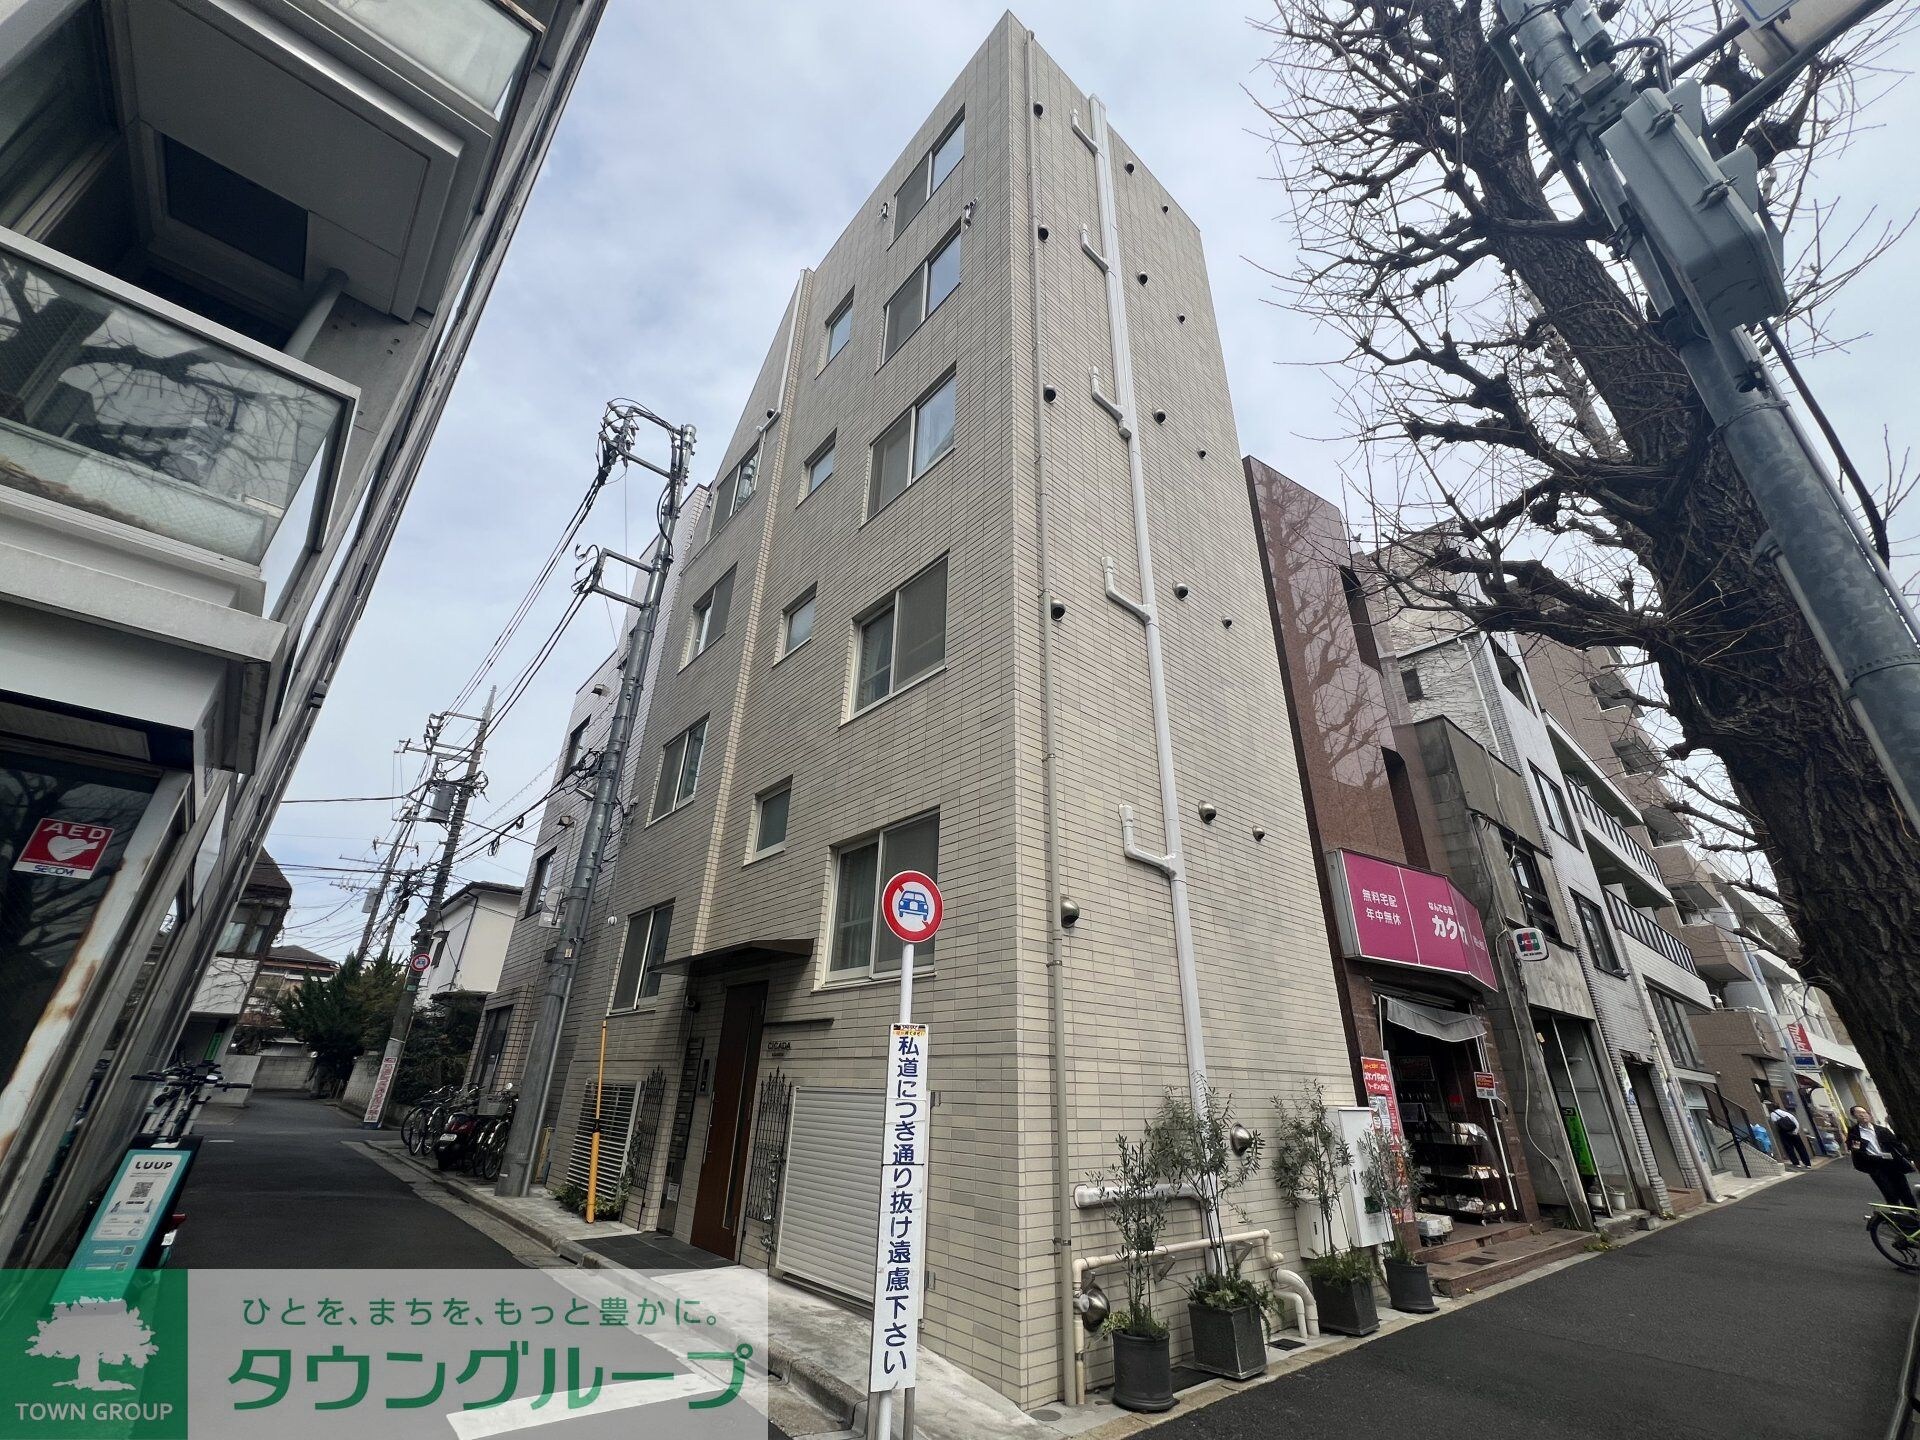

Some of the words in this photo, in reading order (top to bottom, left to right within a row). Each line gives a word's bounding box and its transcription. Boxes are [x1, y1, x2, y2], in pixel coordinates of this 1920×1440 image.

[43, 822, 106, 840] AED
[33, 864, 75, 877] SECOM
[1362, 888, 1398, 908] 無料宅配
[1365, 907, 1402, 926] 年中無休
[135, 1161, 173, 1170] LUUP
[884, 1036, 920, 1374] 私道につき通り抜け遠慮下さい
